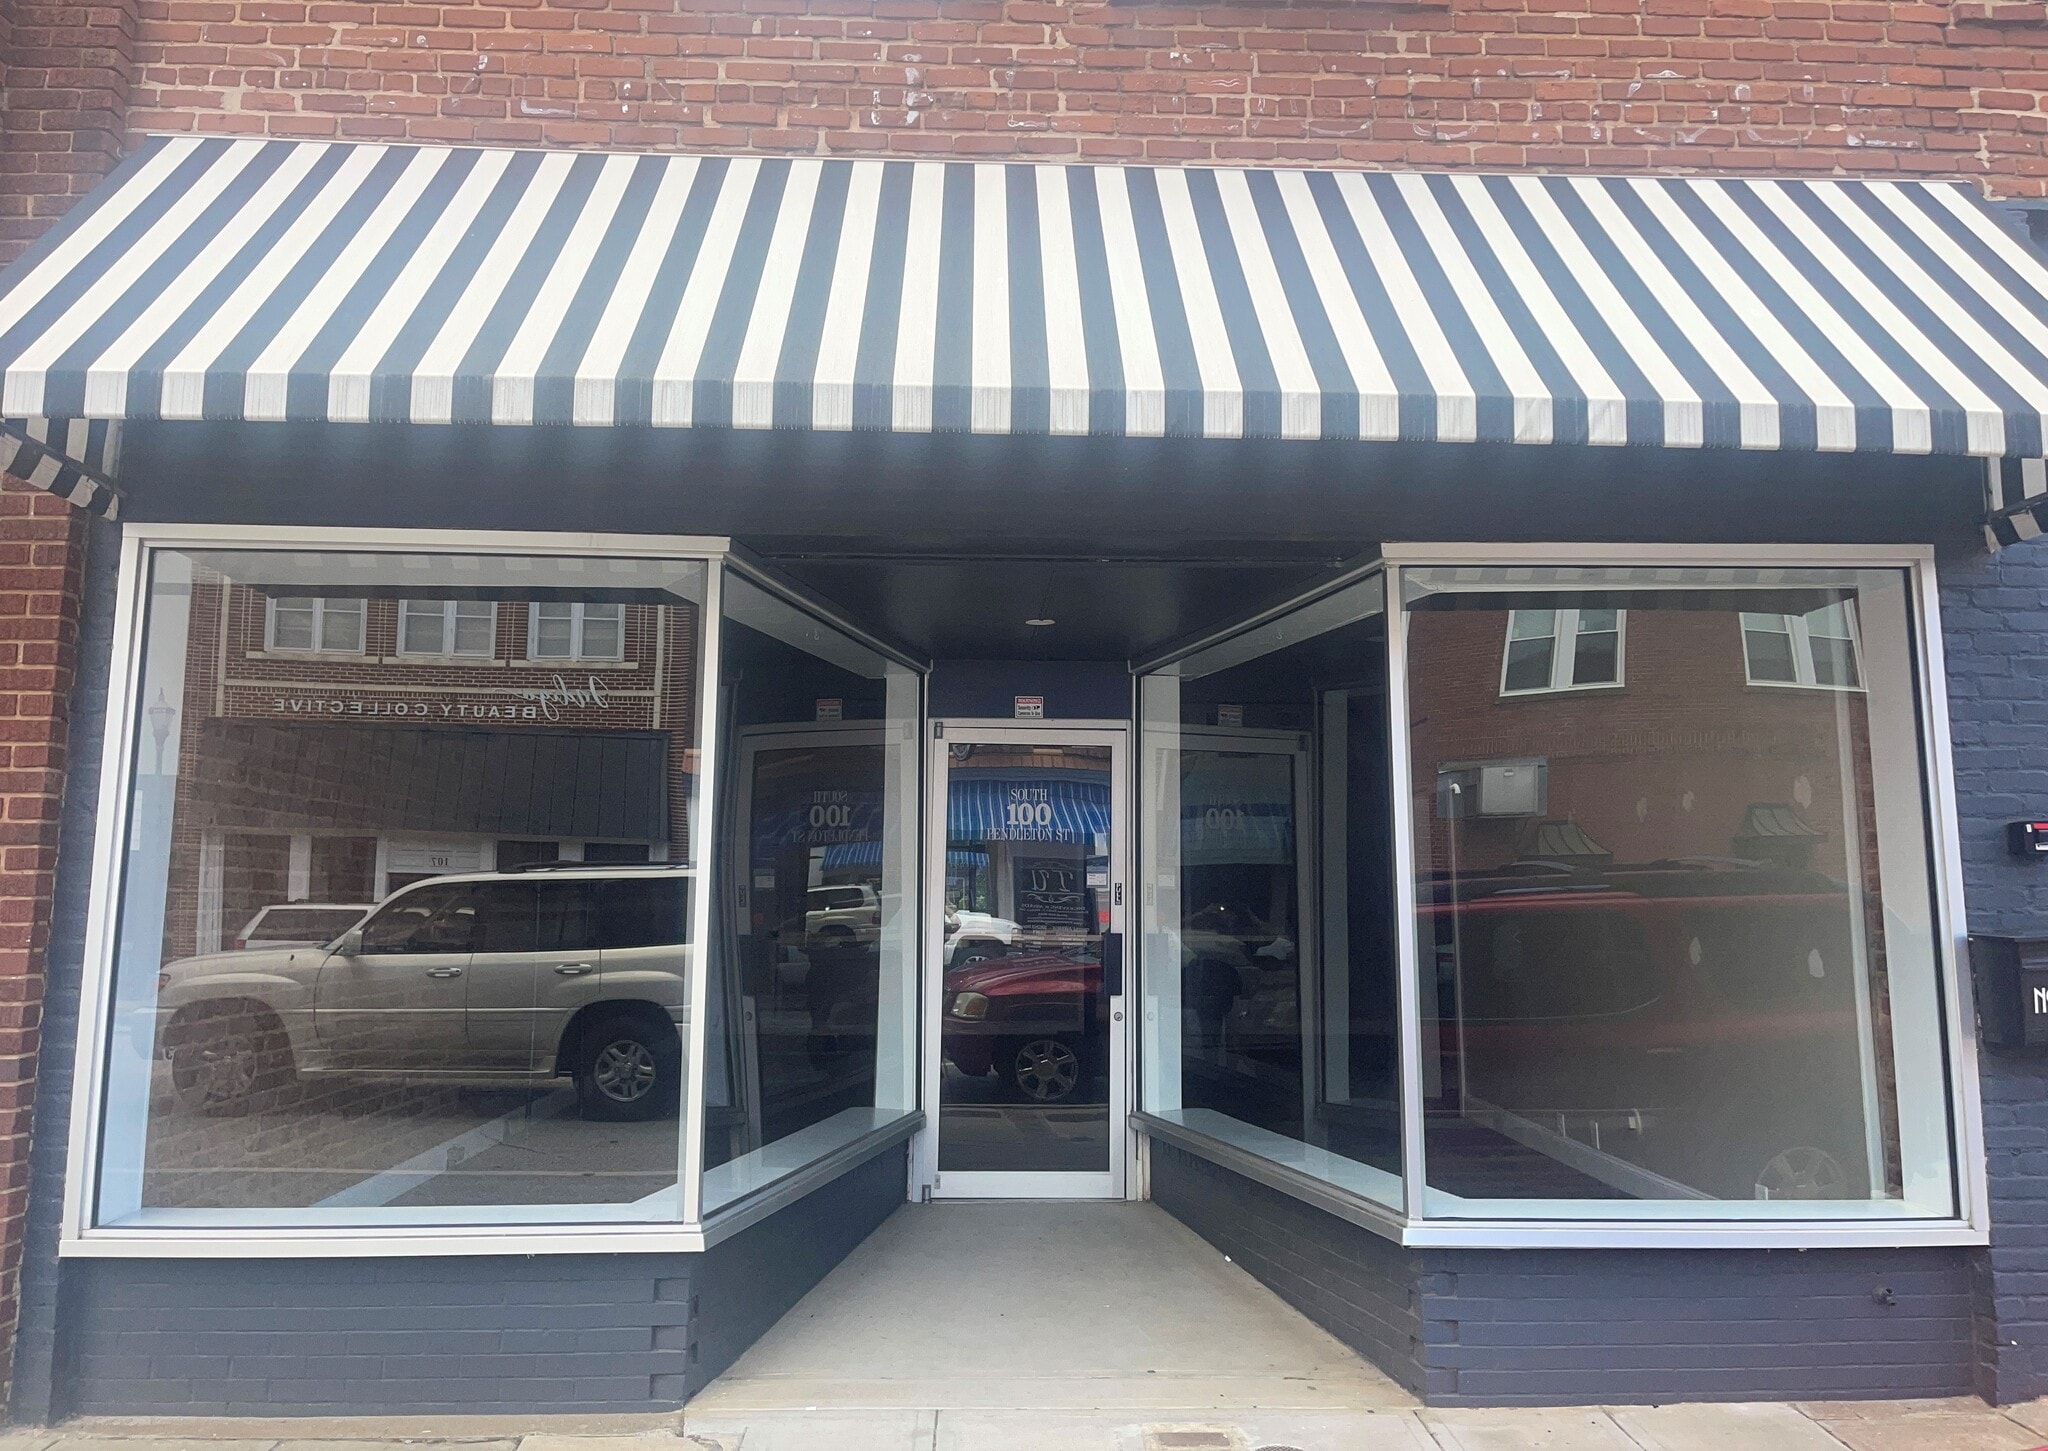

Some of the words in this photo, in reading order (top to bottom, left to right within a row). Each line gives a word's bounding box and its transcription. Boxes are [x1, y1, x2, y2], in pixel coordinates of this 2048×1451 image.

[1010, 788, 1048, 801] SOUTH
[1006, 803, 1051, 825] 100
[987, 828, 1052, 841] PENDLETON
[1056, 827, 1071, 840] ST
